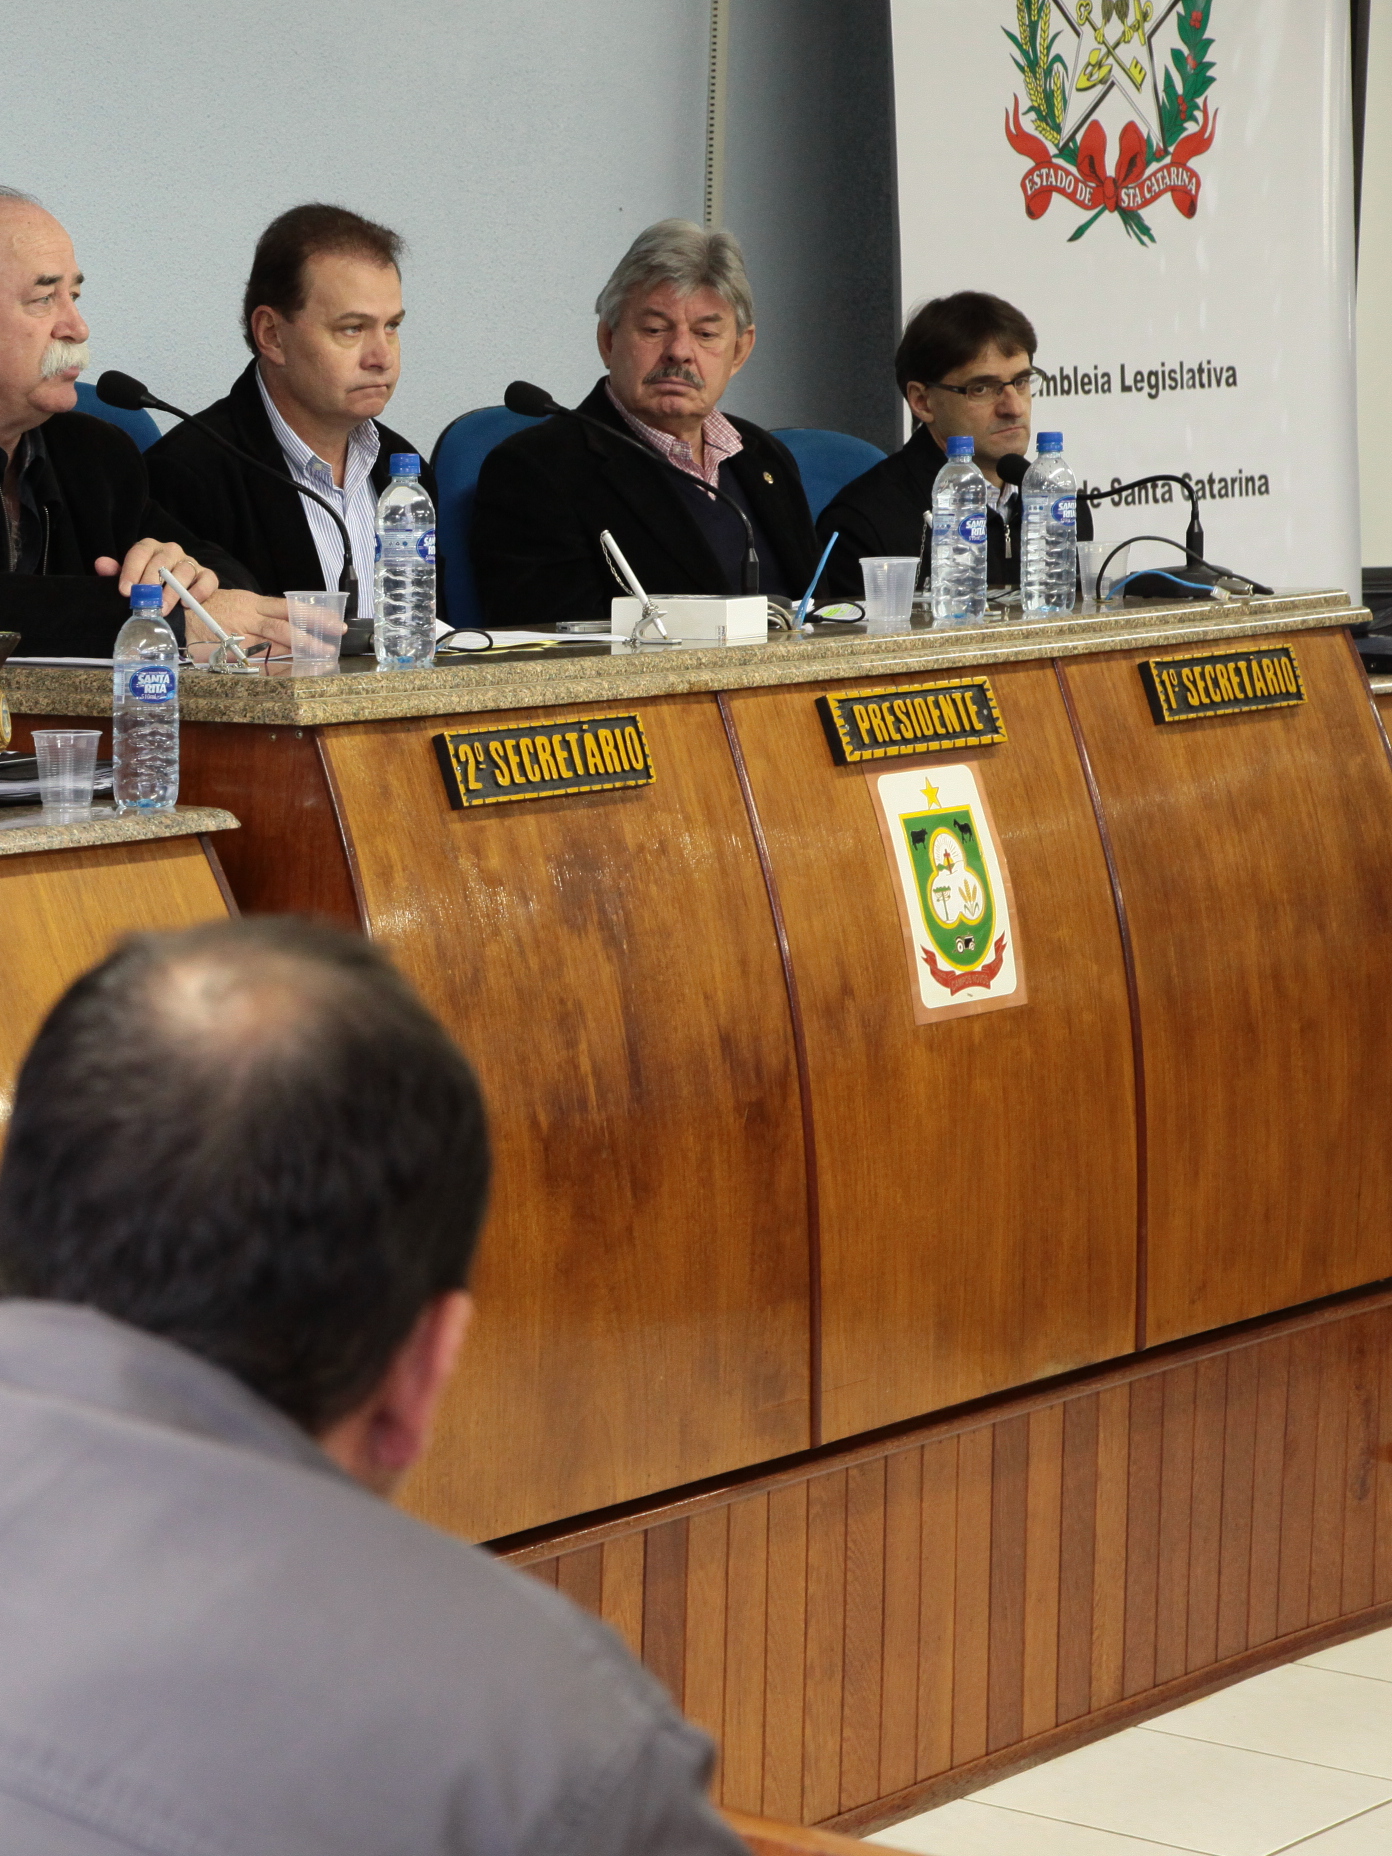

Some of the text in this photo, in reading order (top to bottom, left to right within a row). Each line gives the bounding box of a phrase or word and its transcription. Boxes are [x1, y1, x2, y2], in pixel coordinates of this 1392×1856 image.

[1025, 166, 1196, 207] ESTADO DE STA. CATARINA
[1032, 359, 1238, 399] mbleia Legislativa
[1110, 475, 1174, 507] Santa
[1180, 468, 1270, 502] Catarina
[137, 673, 171, 685] SANTA
[143, 683, 167, 694] RITA
[1181, 655, 1297, 707] SECRETÁRIO
[852, 691, 984, 745] PRESIDENTE
[488, 724, 645, 787] SECRETÁRIO
